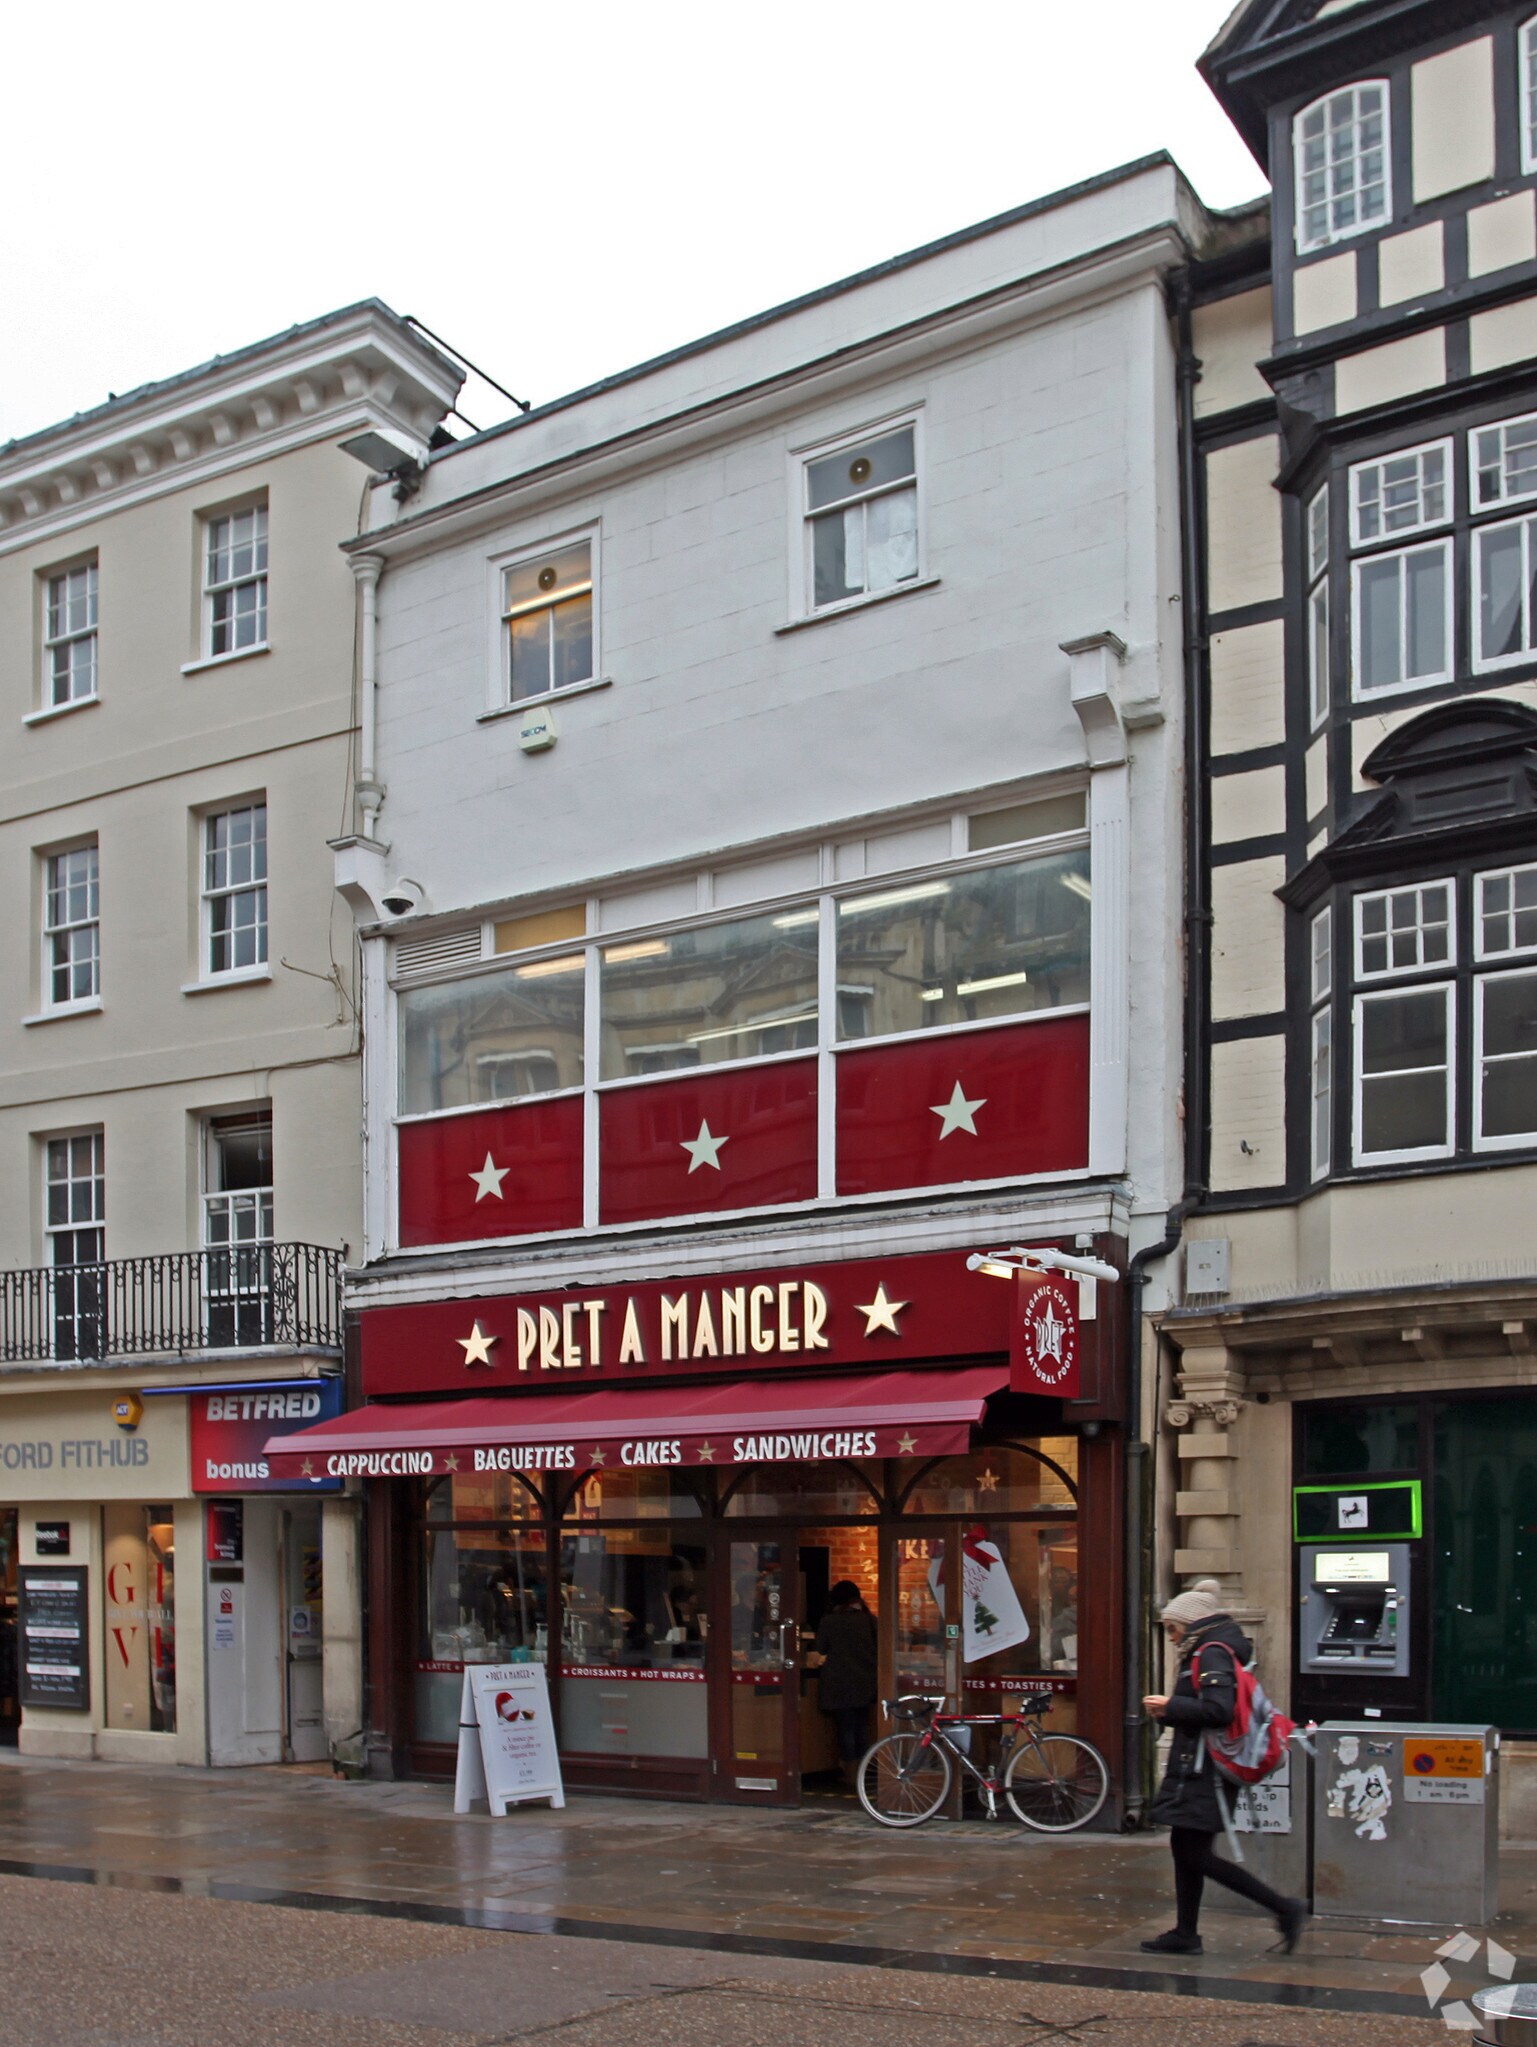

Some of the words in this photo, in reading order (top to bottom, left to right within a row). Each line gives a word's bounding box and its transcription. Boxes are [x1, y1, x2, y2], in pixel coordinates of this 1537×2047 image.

[1024, 1285, 1052, 1327] ORGANIC
[1053, 1288, 1075, 1335] COFFEE
[517, 1300, 605, 1370] PRET
[619, 1296, 645, 1364] A
[661, 1280, 829, 1361] MANGER
[1025, 1346, 1057, 1385] NATURAL
[1057, 1351, 1073, 1381] FOOD
[206, 1392, 321, 1421] BETFRED
[61, 1438, 149, 1469] FITHUB
[326, 1451, 433, 1476] CAPPUCCINO
[474, 1445, 576, 1471] BAGUETTES
[620, 1440, 682, 1466] CAKES
[733, 1431, 877, 1461] SANDWICHES
[206, 1459, 270, 1480] bonus
[426, 1662, 451, 1671] LATTE
[571, 1667, 628, 1678] CROISSANTS
[640, 1669, 660, 1679] HOT
[661, 1671, 695, 1681] WRAPS
[1001, 1680, 1053, 1691] TOASTIES
[1435, 1781, 1467, 1789] loading
[1236, 1803, 1268, 1812] stds
